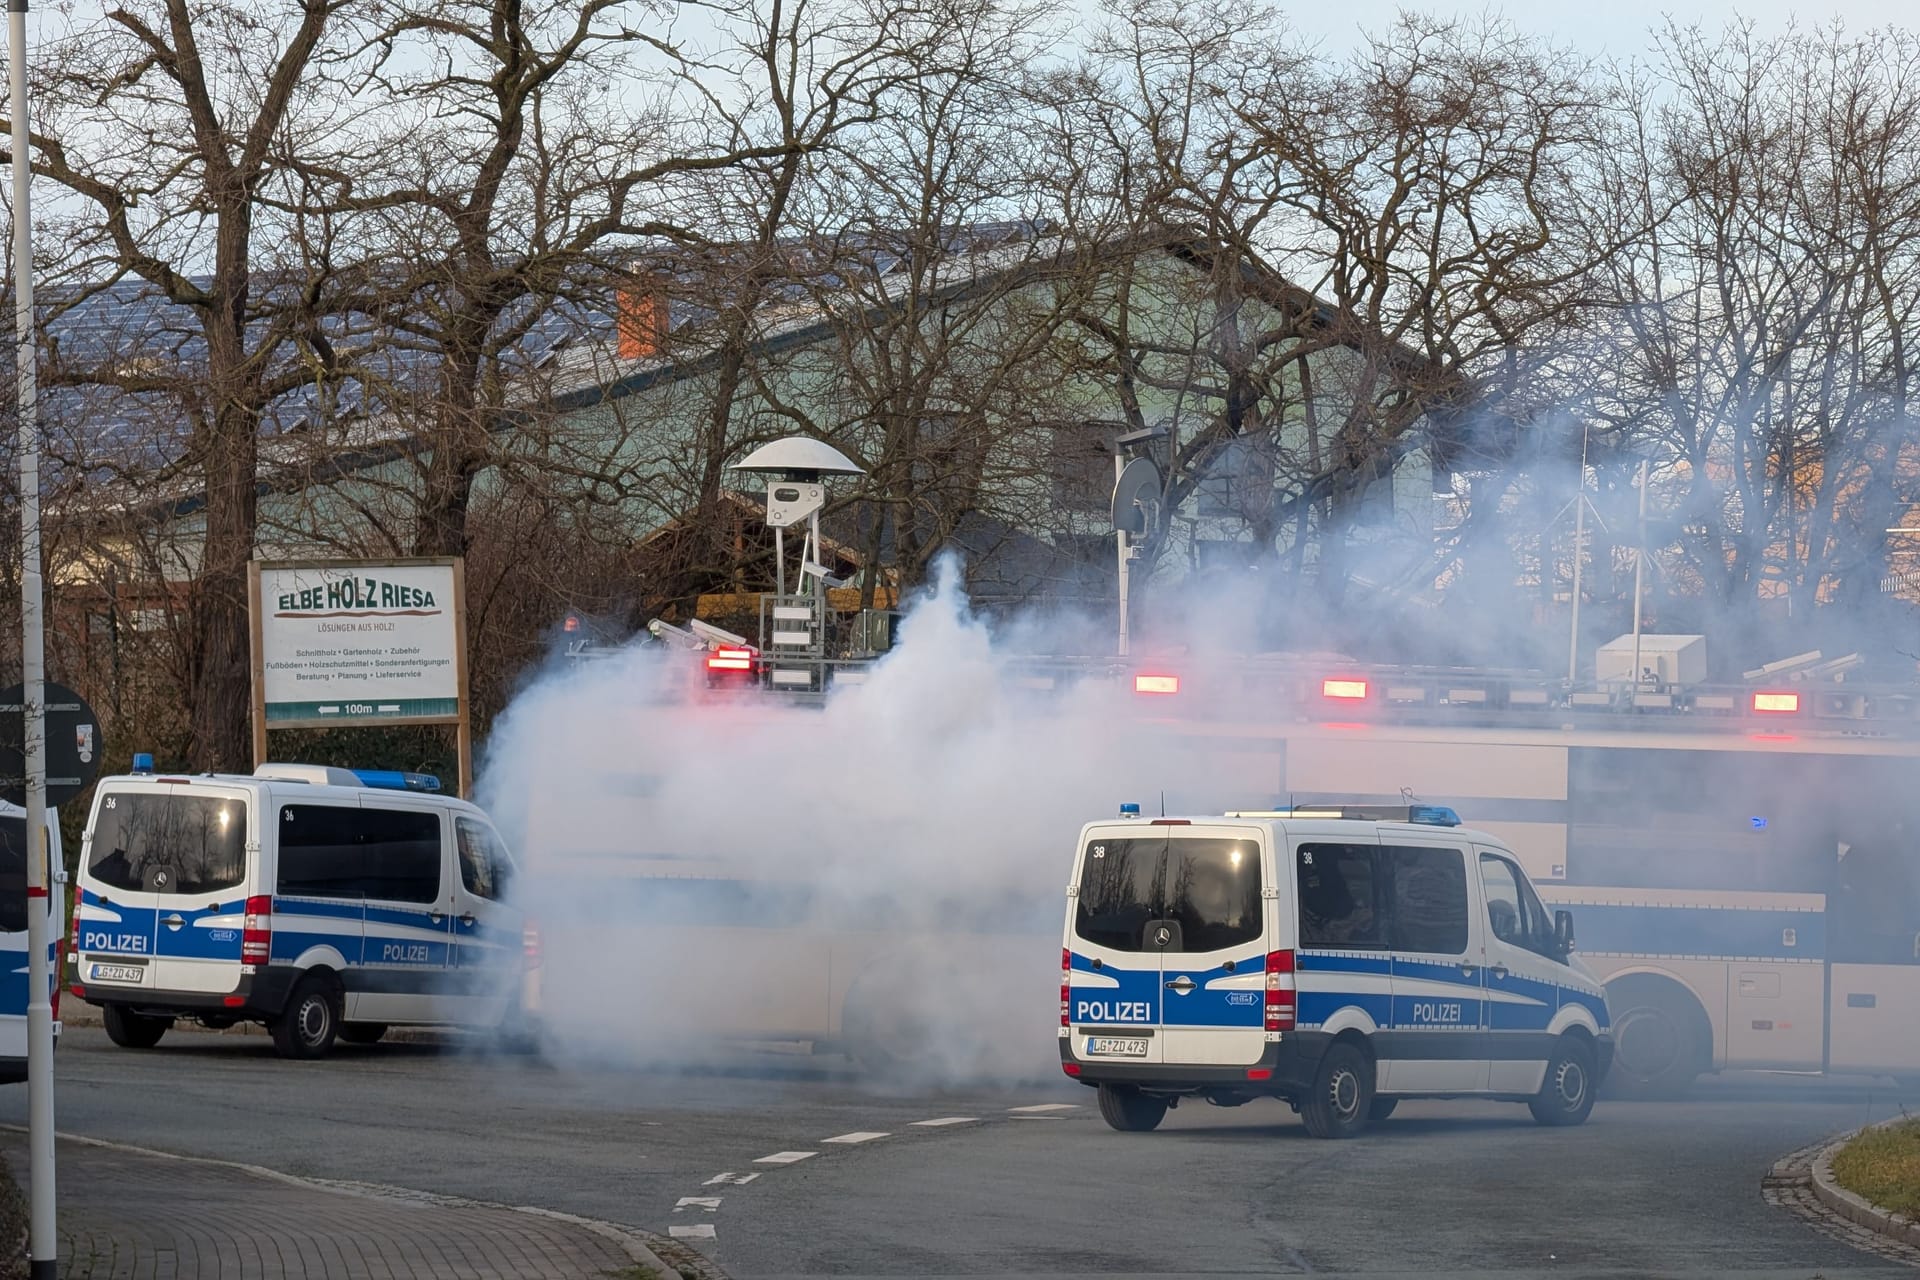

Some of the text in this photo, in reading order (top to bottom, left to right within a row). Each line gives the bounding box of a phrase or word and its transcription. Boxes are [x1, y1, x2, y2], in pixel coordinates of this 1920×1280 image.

[278, 577, 436, 611] ELBE HOLZ RIESA
[317, 622, 395, 633] LÖSUNGEN AUS HOLZ!
[343, 647, 382, 656] Gartenholz
[390, 647, 420, 655] Zubehör
[265, 658, 450, 669] Fußböden Holzschutzmittel Sonderanfertigungen
[296, 671, 422, 681] Beratung Planung Lieferservice
[344, 703, 373, 713] 100m
[106, 798, 116, 809] 36
[285, 810, 294, 821] 36
[1093, 846, 1105, 858] 38
[1303, 852, 1313, 864] 38
[85, 932, 147, 952] POLIZEI
[383, 944, 429, 961] POLIZEI
[125, 970, 141, 980] 437
[1078, 1001, 1150, 1021] POLIZEI
[1413, 1003, 1461, 1022] POLIZEI
[1111, 1040, 1126, 1052] ZD
[1127, 1041, 1146, 1053] 473
